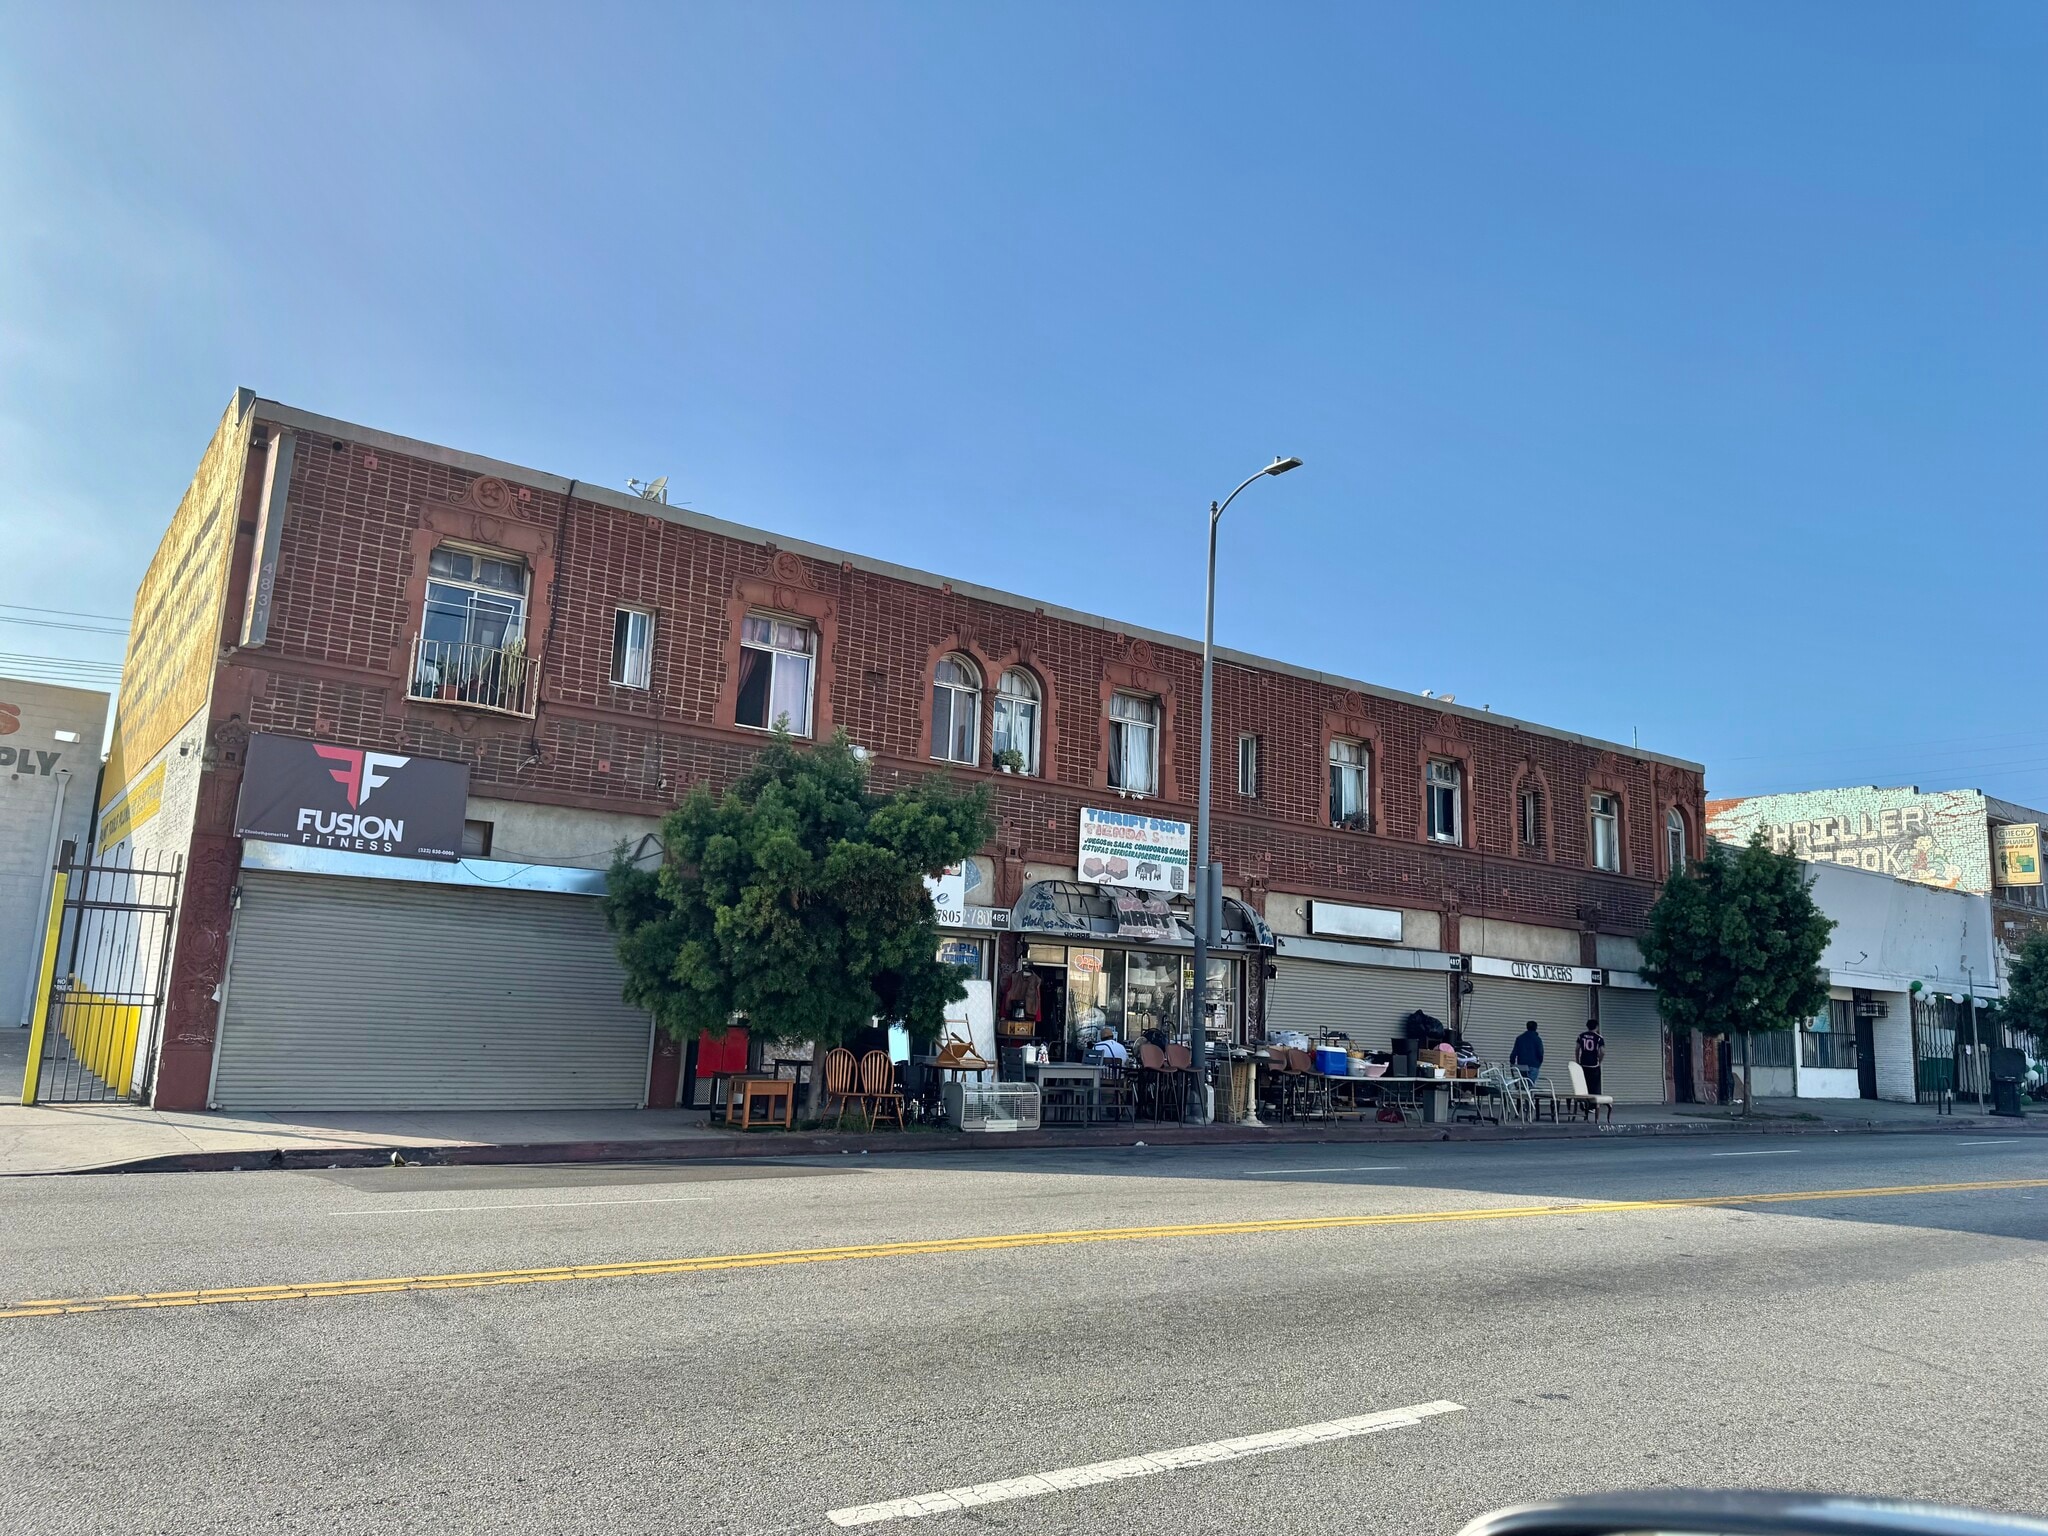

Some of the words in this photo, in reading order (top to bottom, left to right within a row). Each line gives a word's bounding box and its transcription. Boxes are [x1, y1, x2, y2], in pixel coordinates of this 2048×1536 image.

[256, 562, 273, 622] 4831
[297, 807, 404, 842] FUSION
[1085, 823, 1147, 842] TIENDA
[1087, 809, 1147, 829] THRIFT
[1149, 818, 1185, 836] Store
[302, 833, 393, 853] FITNESS
[1999, 829, 2026, 838] CHECK
[1084, 838, 1107, 847] JUEGOS
[1113, 841, 1133, 850] SALAS
[1169, 848, 1189, 858] CAMAS
[993, 913, 1008, 922] 4821
[942, 943, 978, 955] TAPIA
[1511, 962, 1530, 977] CITY
[1532, 963, 1573, 982] SLICKERS
[1582, 1038, 1595, 1051] 10
